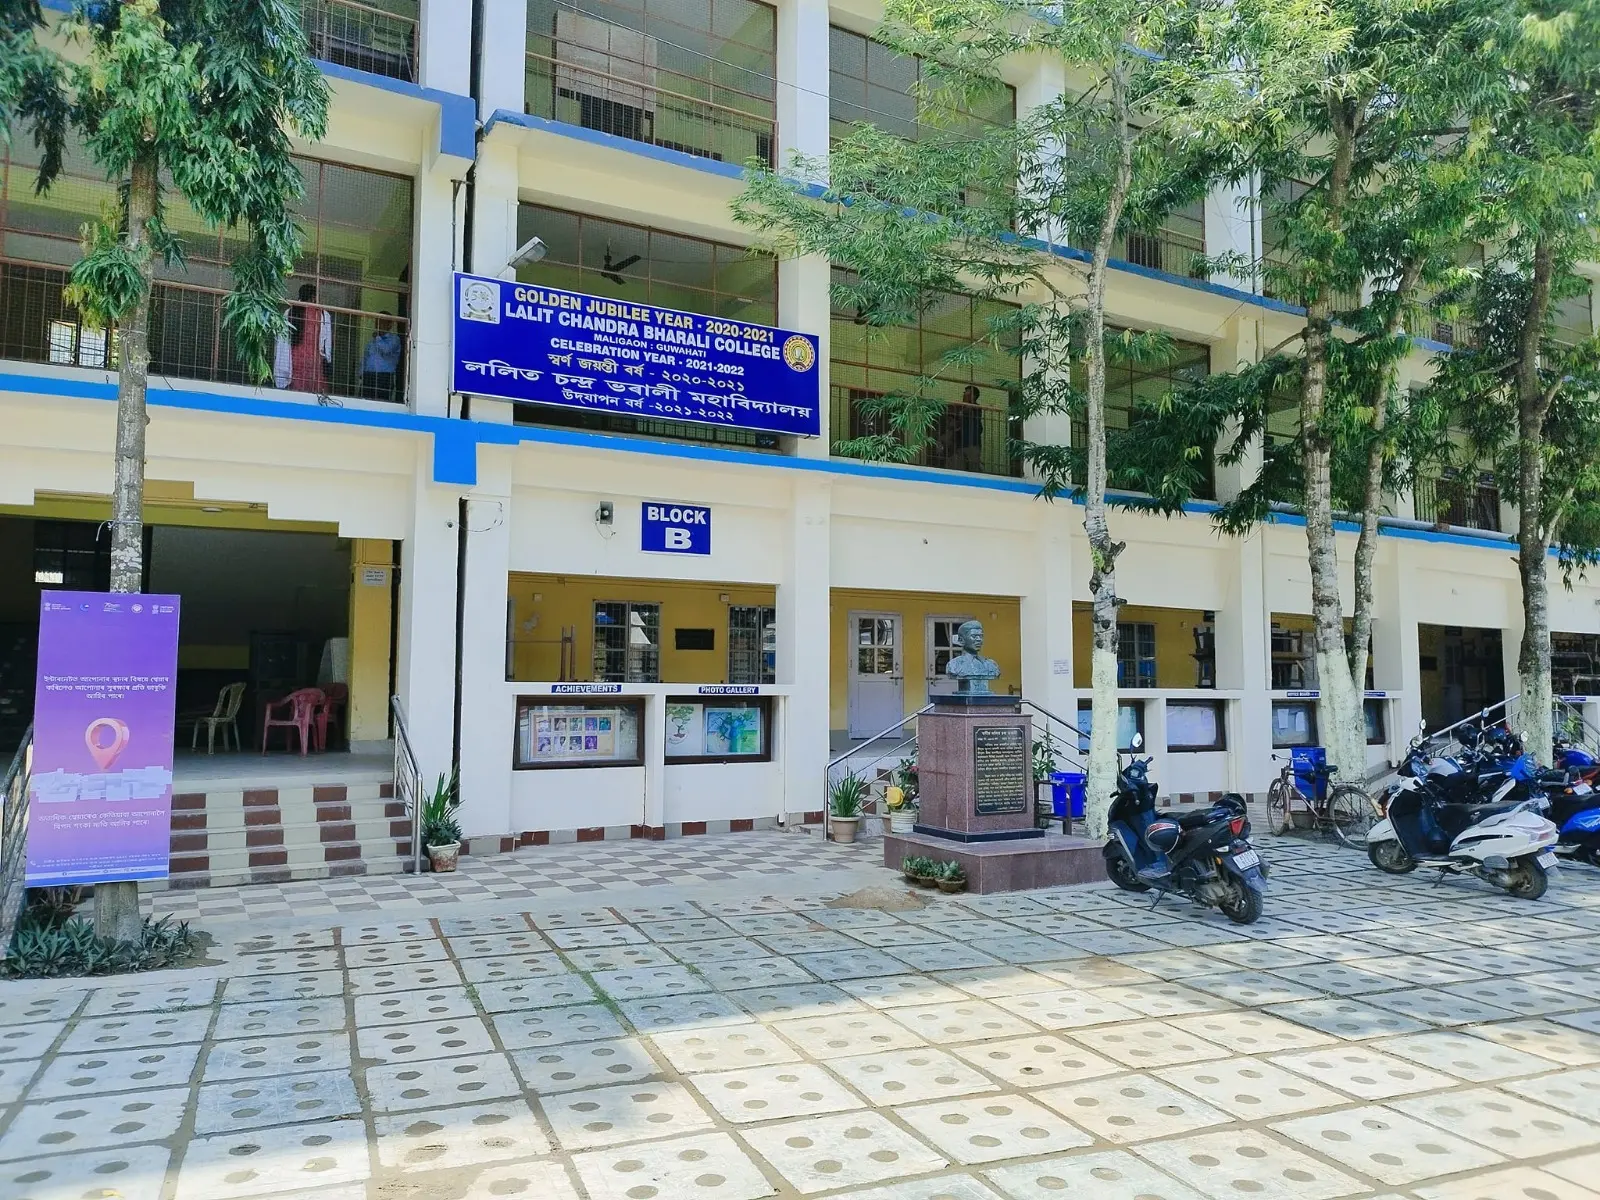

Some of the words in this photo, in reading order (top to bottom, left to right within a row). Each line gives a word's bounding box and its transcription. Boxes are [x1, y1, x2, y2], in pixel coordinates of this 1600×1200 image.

[514, 287, 581, 311] GOLDEN
[586, 299, 650, 322] JUBILEE
[655, 311, 693, 330] YEAR
[705, 320, 774, 343] 2020-2021
[505, 302, 553, 323] LALIT
[558, 312, 639, 337] CHANDRA
[643, 325, 710, 349] BHARALI
[714, 337, 781, 360] COLLEGE
[550, 337, 640, 360] CELEBRATION
[643, 351, 676, 366] YEAR
[685, 358, 745, 376] 2021-2022
[593, 333, 648, 349] MALIGAON
[656, 343, 707, 358] GUWAHATI
[461, 359, 545, 382] ললিত
[647, 506, 707, 525] BLOCK
[665, 527, 692, 550] B
[555, 684, 618, 693] ACHIEVEMENTS
[701, 686, 725, 694] PHOTO
[725, 686, 756, 694] GALLERY
